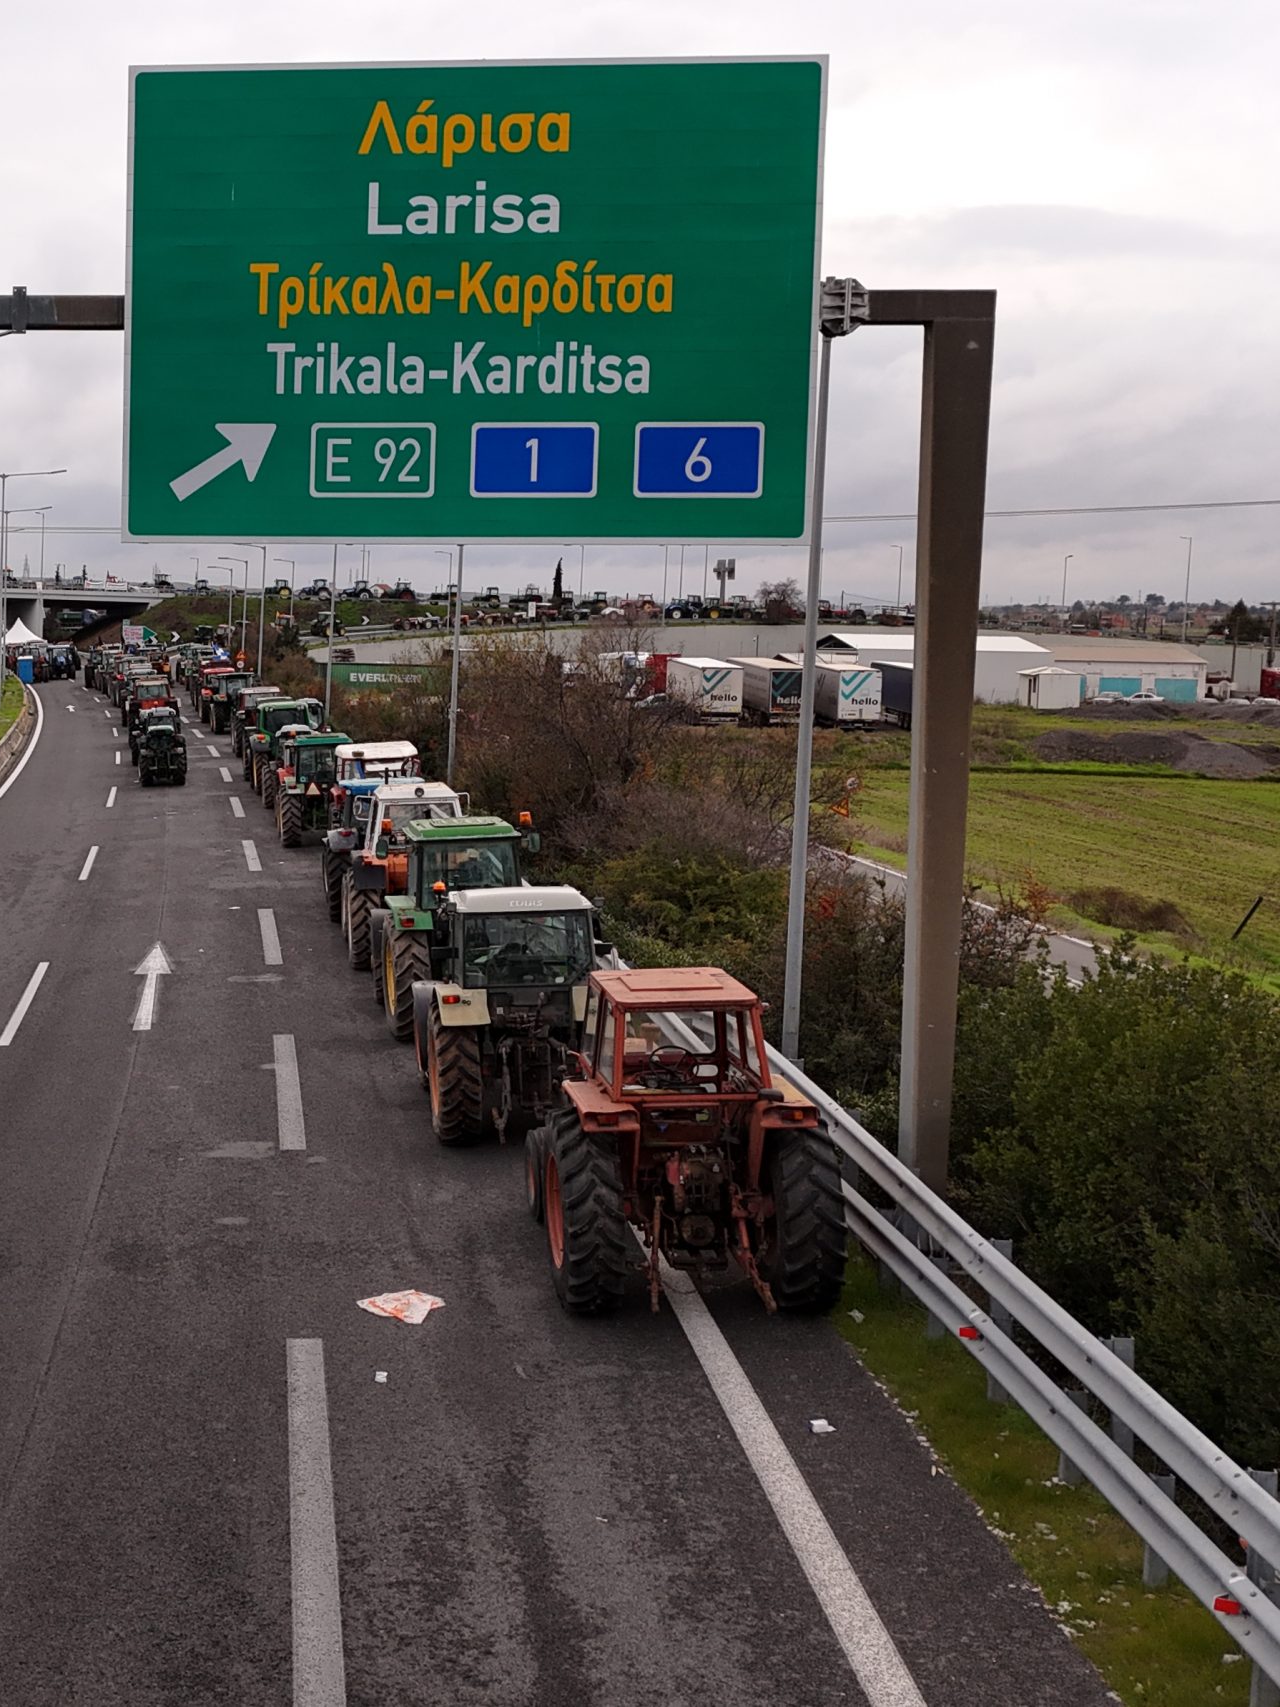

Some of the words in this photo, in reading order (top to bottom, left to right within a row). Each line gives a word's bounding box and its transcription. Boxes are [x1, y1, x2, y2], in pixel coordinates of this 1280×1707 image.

[359, 100, 570, 167] Λάρισα
[368, 181, 559, 234] Larisa
[250, 260, 673, 328] Τρίκαλα-Καρδίτσα
[267, 342, 650, 394] Trikala-Karditsa
[326, 439, 352, 482] E
[374, 438, 421, 482] 92
[525, 439, 539, 482] 1
[684, 438, 712, 483] 6
[851, 697, 878, 705] hello
